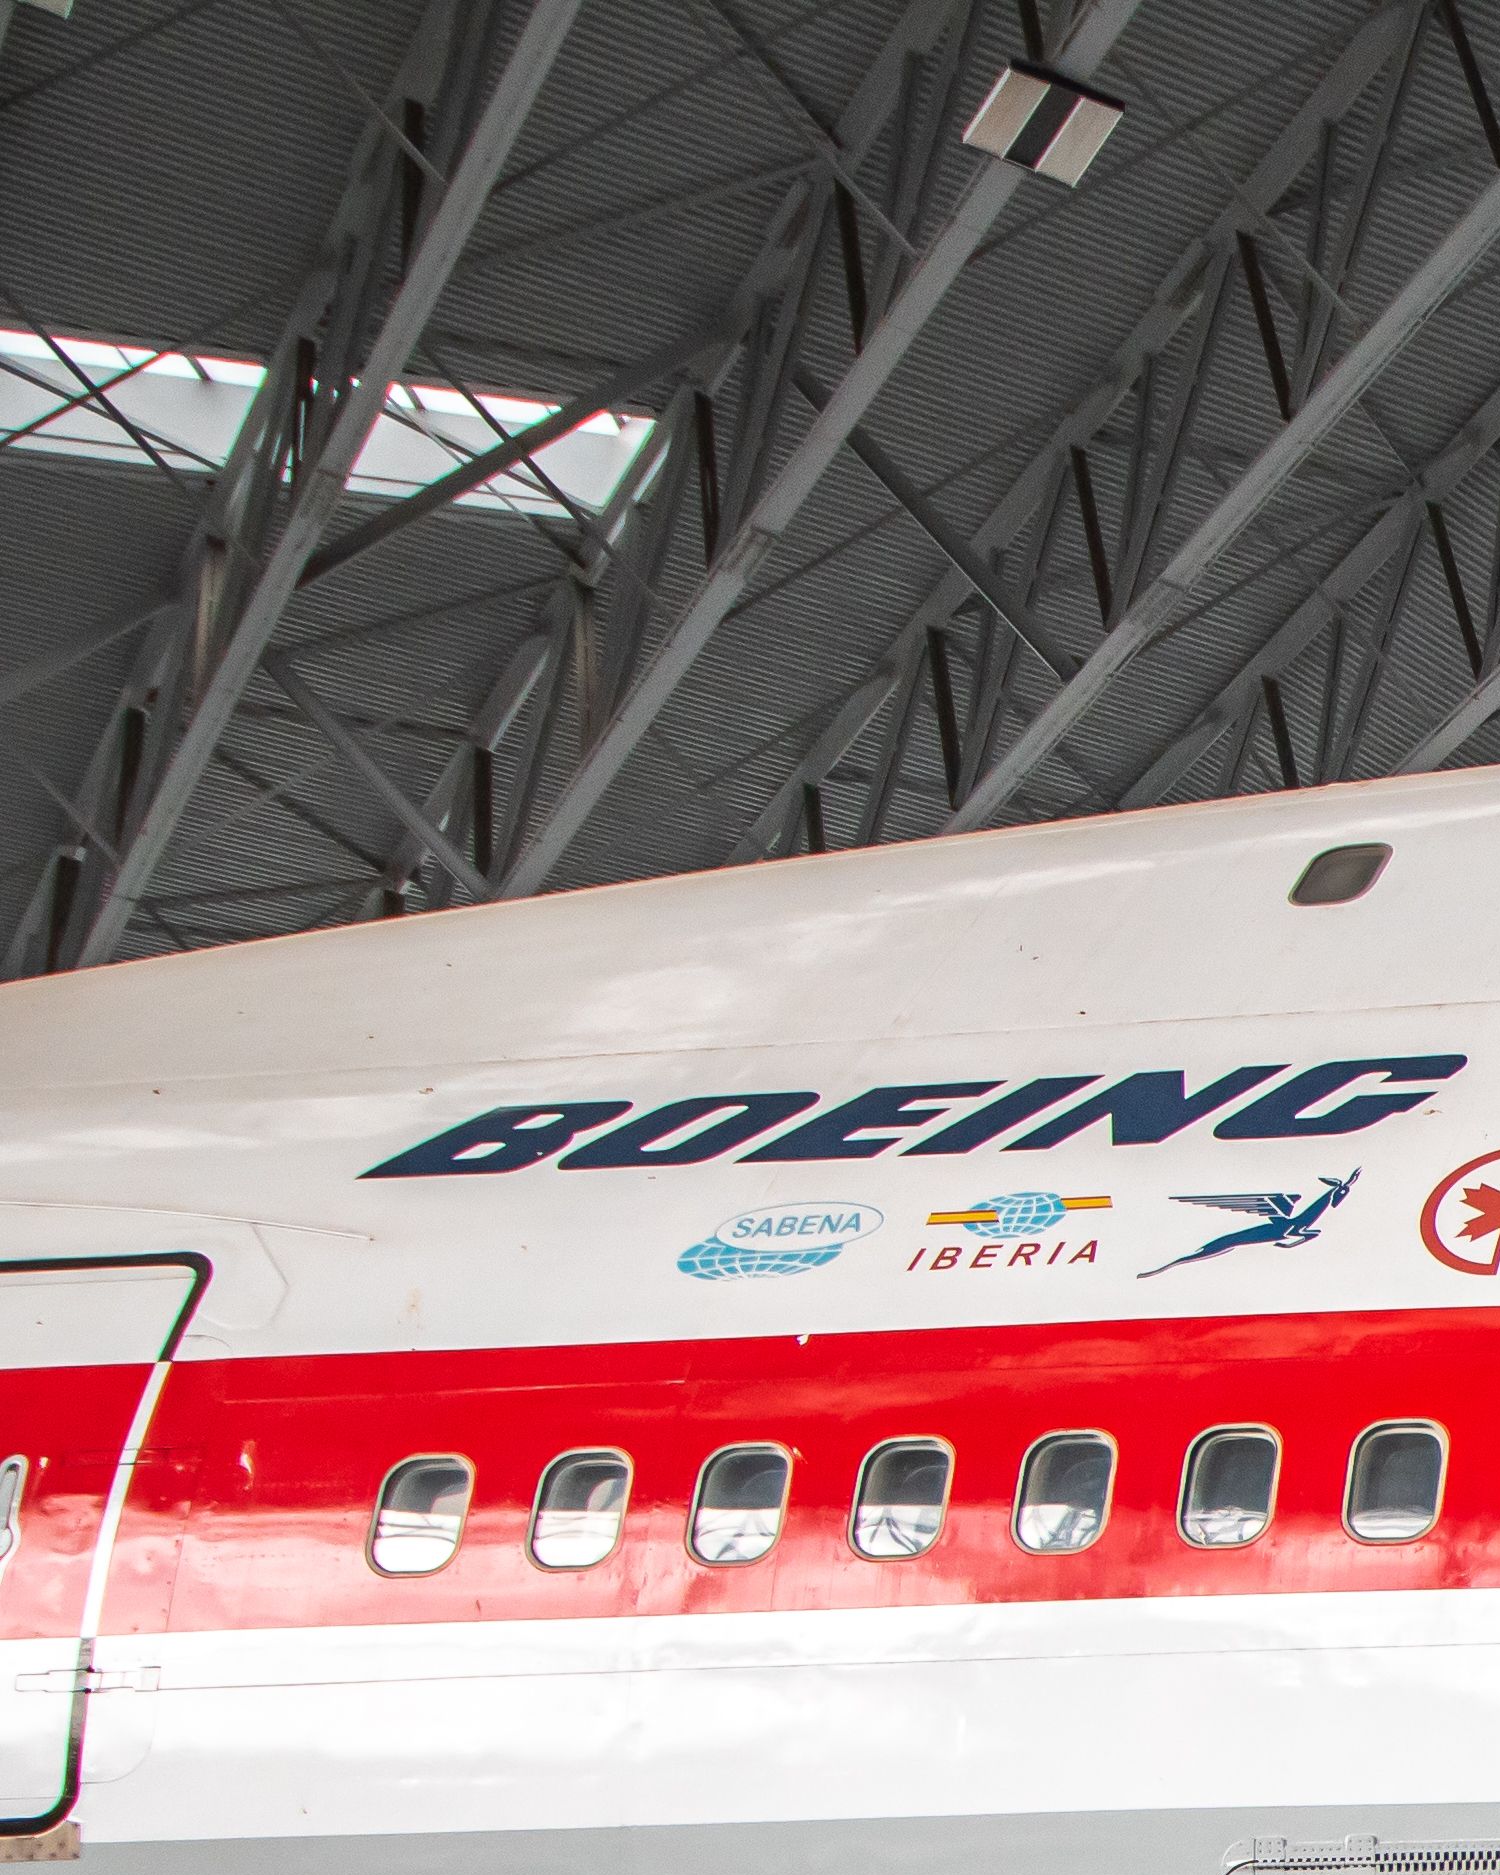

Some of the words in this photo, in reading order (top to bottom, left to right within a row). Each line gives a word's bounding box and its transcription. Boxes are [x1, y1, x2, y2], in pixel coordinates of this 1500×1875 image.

[356, 1054, 1468, 1180] BOEING
[731, 1212, 862, 1237] SABENA
[906, 1239, 1100, 1272] IBERIA
